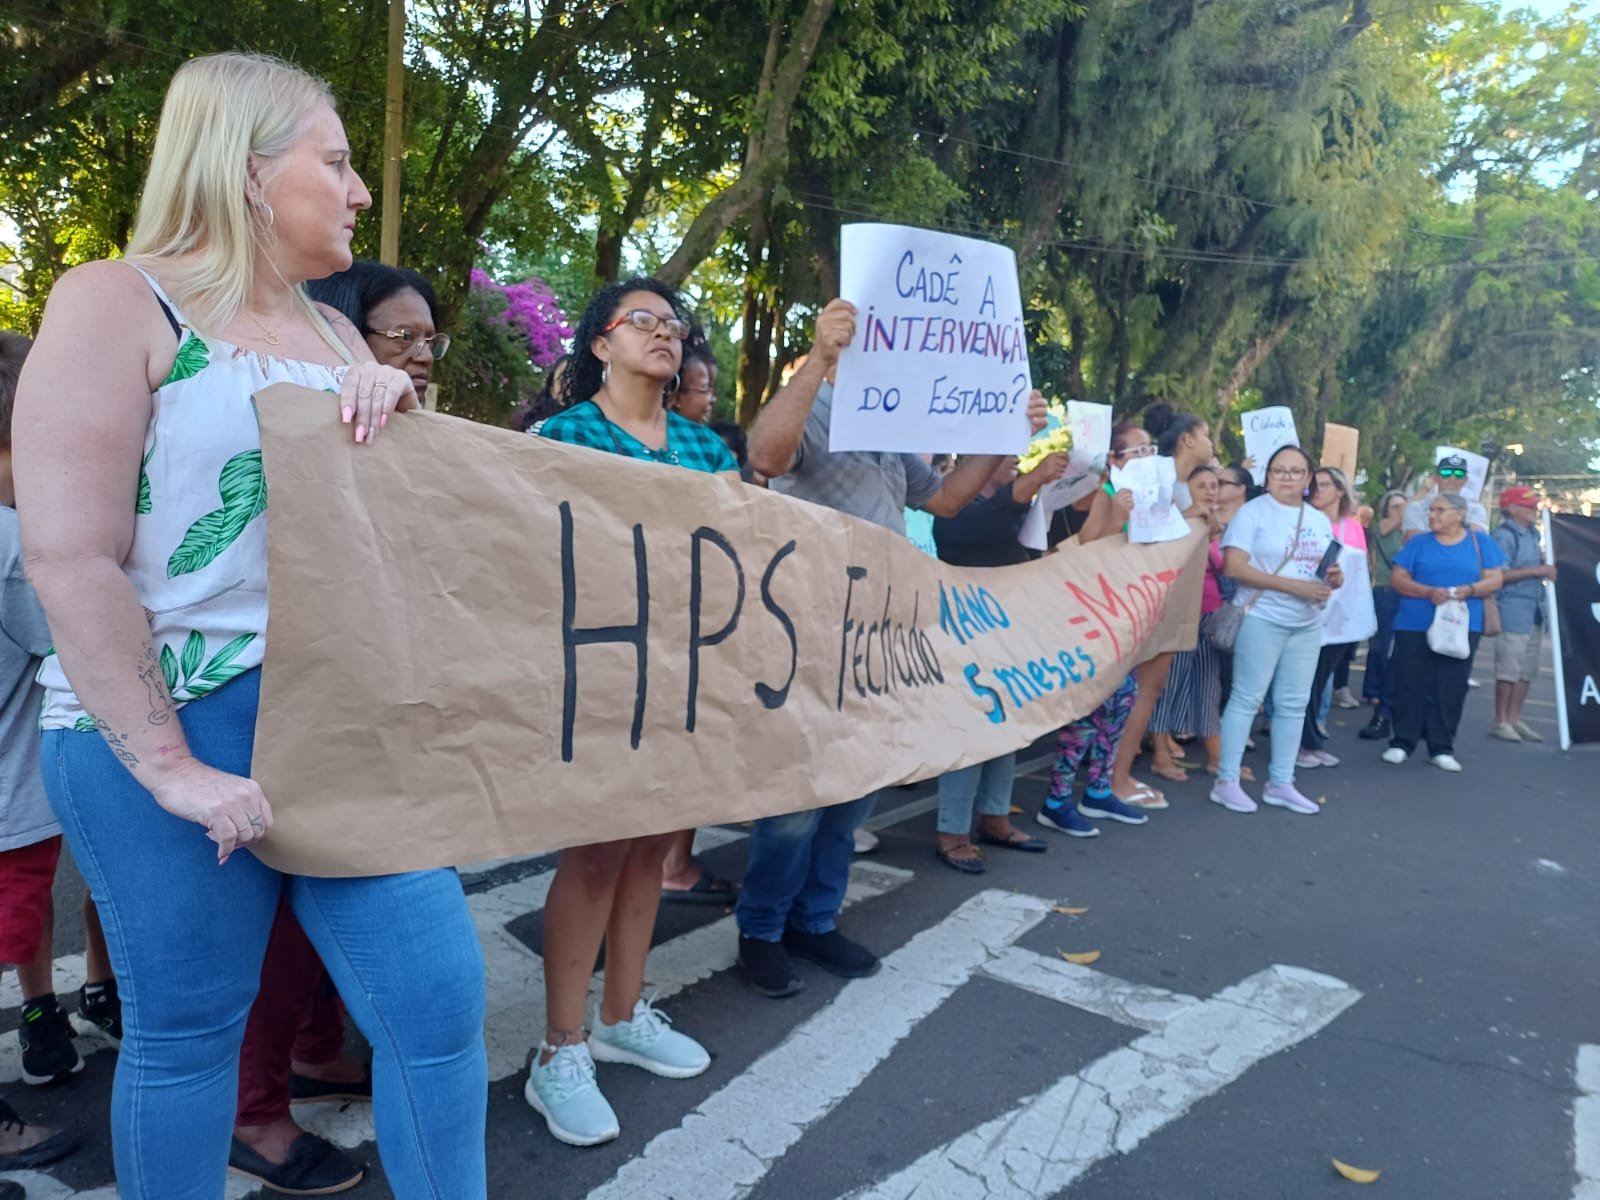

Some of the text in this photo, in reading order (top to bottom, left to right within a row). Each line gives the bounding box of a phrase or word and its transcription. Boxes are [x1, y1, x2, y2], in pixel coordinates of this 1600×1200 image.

[896, 250, 996, 318] CADÊ A
[863, 306, 1026, 364] INTERVENÇÃ
[857, 373, 1027, 416] DO ESTADO?
[559, 500, 798, 763] HPS
[837, 565, 945, 712] Fechado
[963, 662, 1006, 724] 5
[993, 645, 1096, 708] meses
